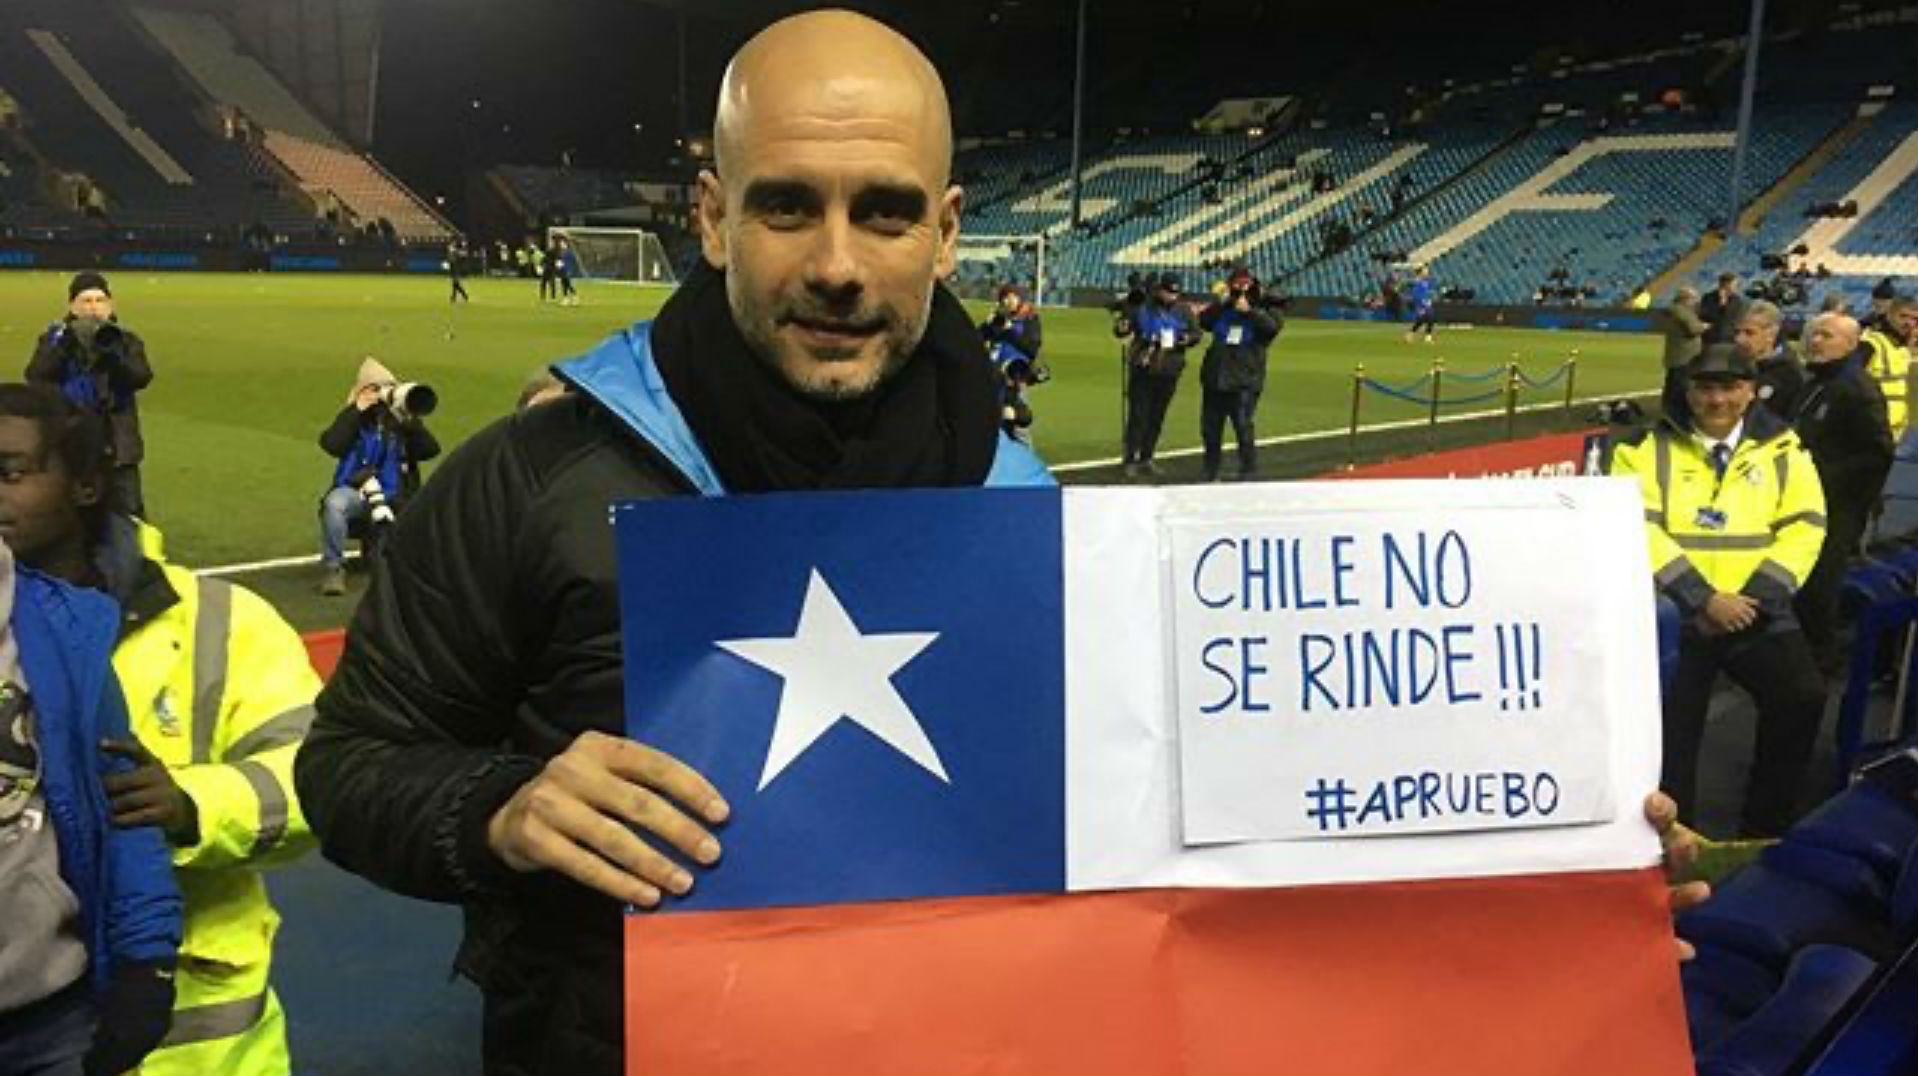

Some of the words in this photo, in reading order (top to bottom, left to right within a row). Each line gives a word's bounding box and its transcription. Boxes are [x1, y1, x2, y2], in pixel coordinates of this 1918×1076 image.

[1193, 536, 1360, 611] CHILE
[1383, 530, 1472, 609] NO
[1200, 637, 1270, 714] SE
[1305, 772, 1559, 830] #APRUEBO
